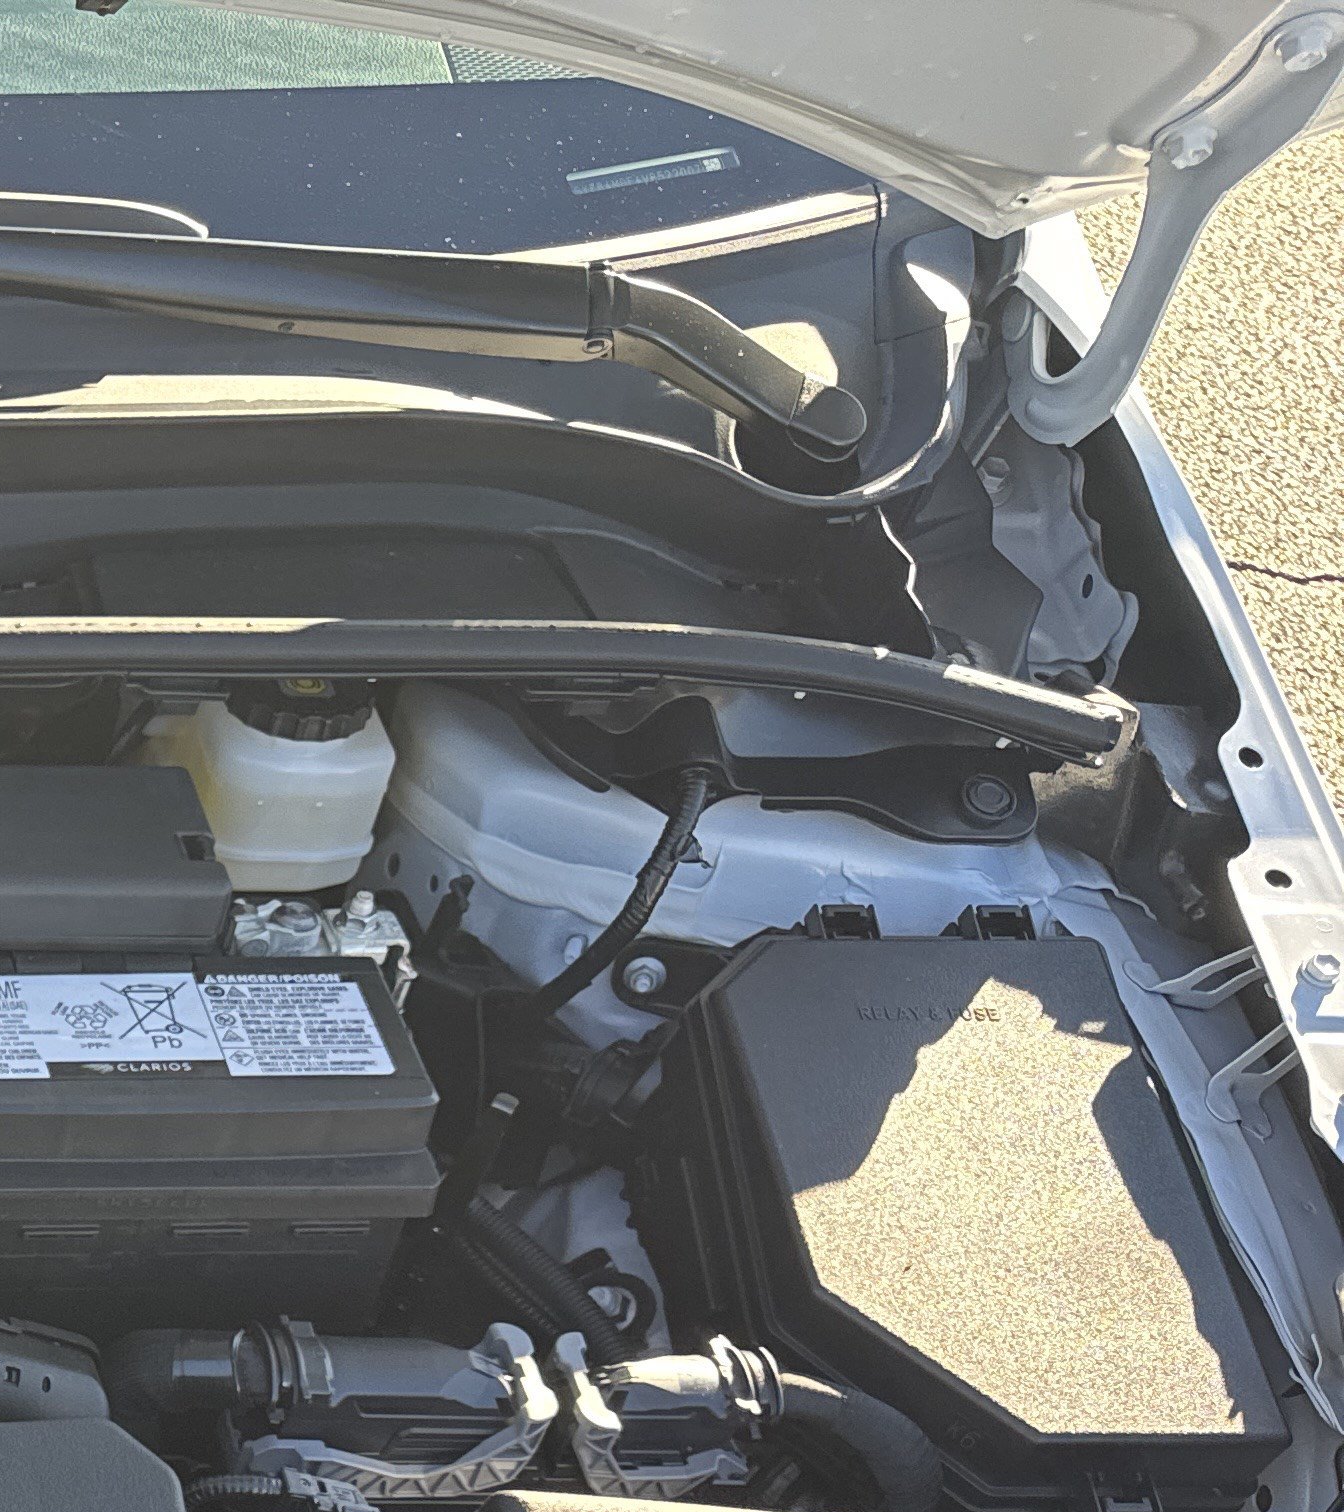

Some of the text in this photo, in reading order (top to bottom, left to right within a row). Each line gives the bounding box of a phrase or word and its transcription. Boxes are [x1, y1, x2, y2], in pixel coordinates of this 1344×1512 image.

[946, 1007, 1001, 1022] FUSE
[151, 1035, 183, 1049] Pb
[117, 1062, 192, 1072] CLARIOS
